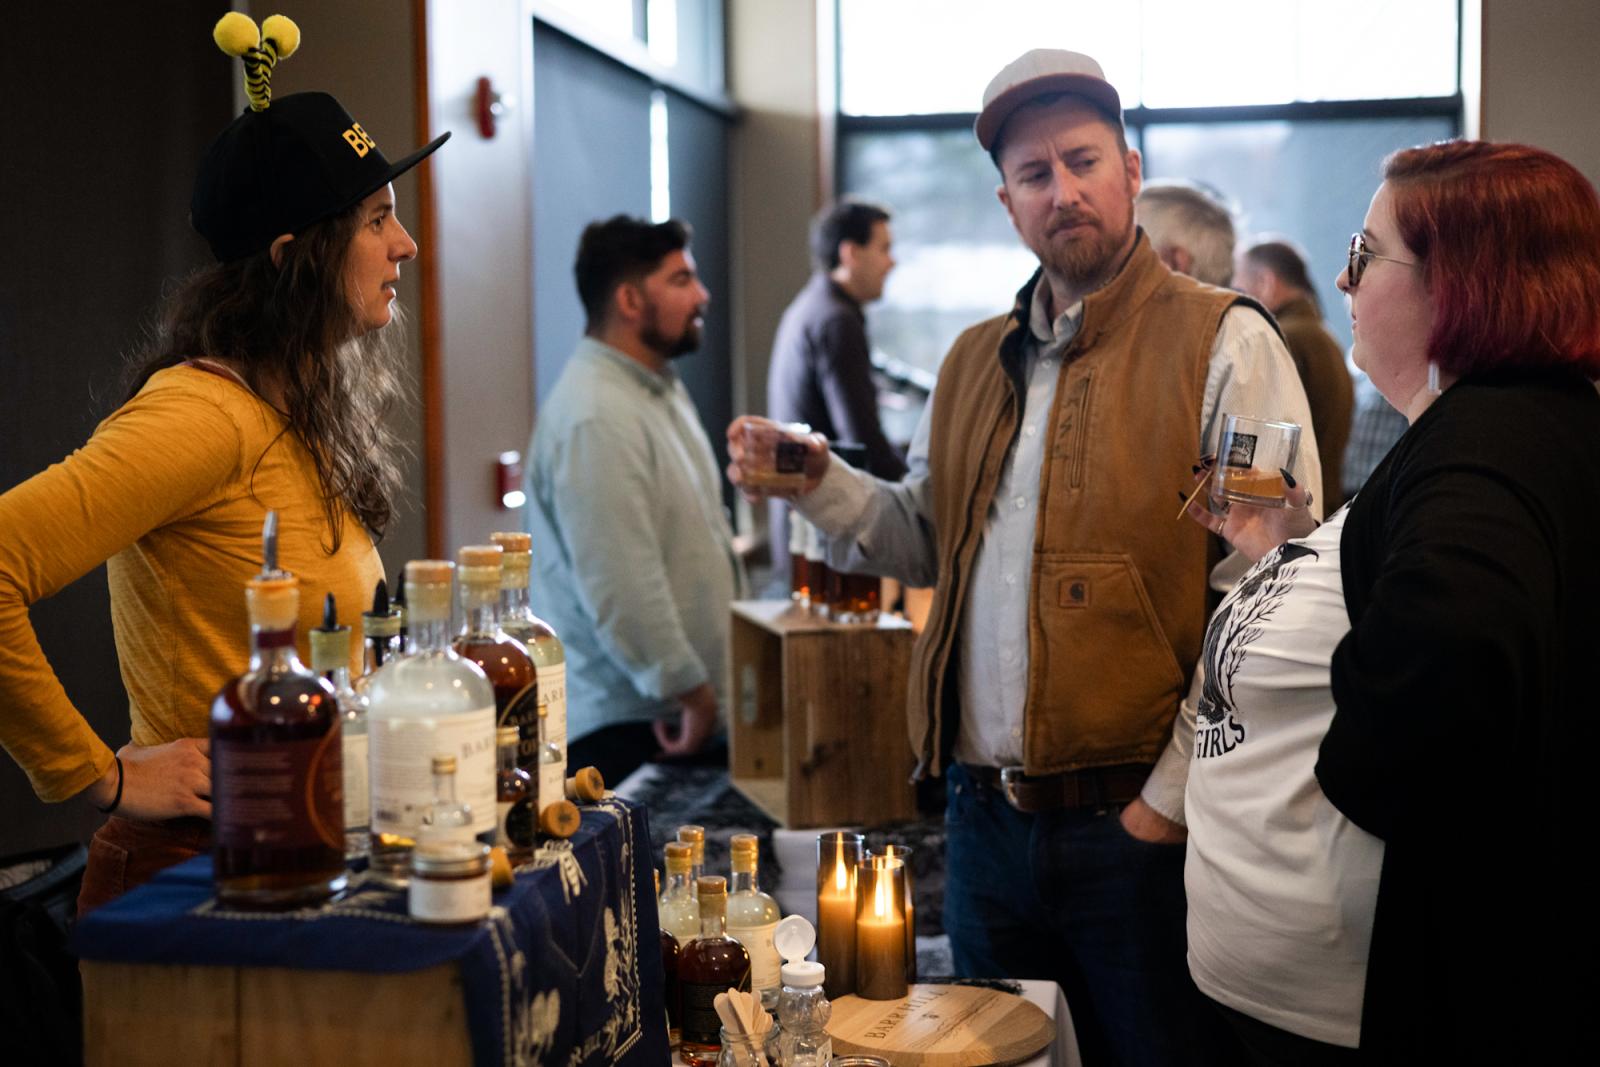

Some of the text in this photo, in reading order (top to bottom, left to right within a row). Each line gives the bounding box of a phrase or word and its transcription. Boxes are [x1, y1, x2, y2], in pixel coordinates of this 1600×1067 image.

[1196, 715, 1245, 759] GIRLS
[864, 990, 949, 1039] BARR HILL
